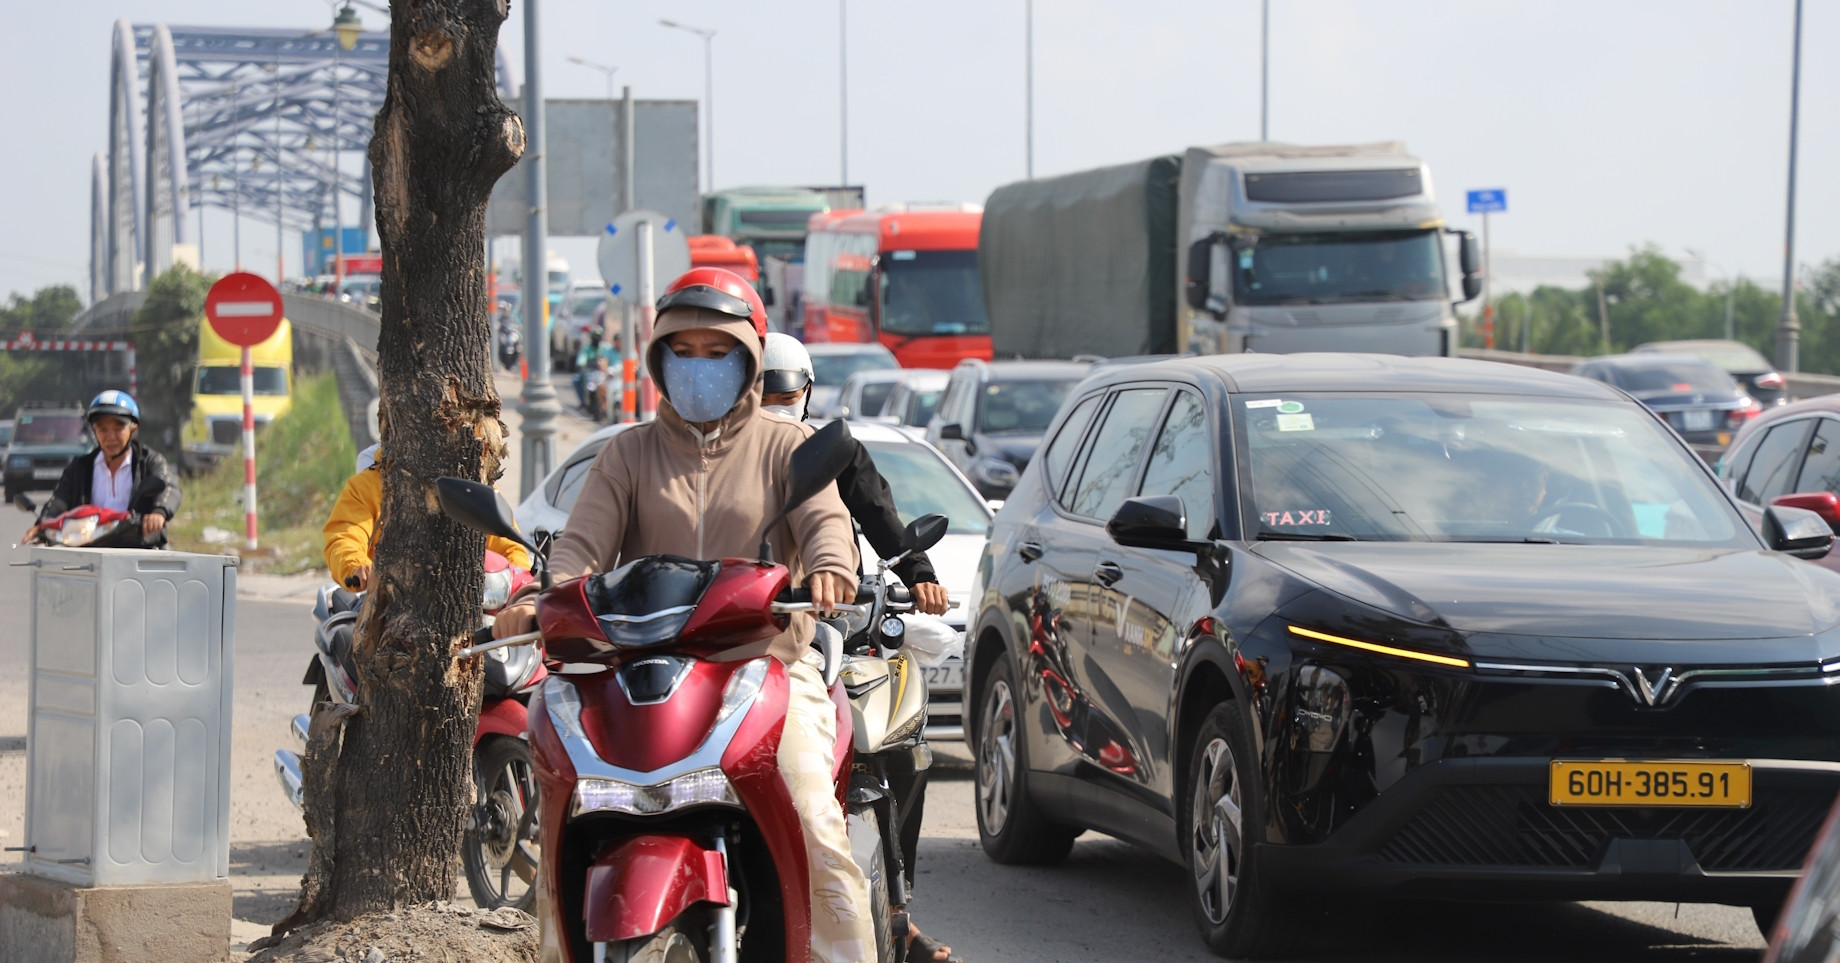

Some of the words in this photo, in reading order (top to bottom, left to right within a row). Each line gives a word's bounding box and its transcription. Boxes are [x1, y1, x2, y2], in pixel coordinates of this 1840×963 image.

[1266, 509, 1326, 526] TAXI
[632, 659, 670, 667] HONDA
[1568, 770, 1730, 798] 60H-385.91
